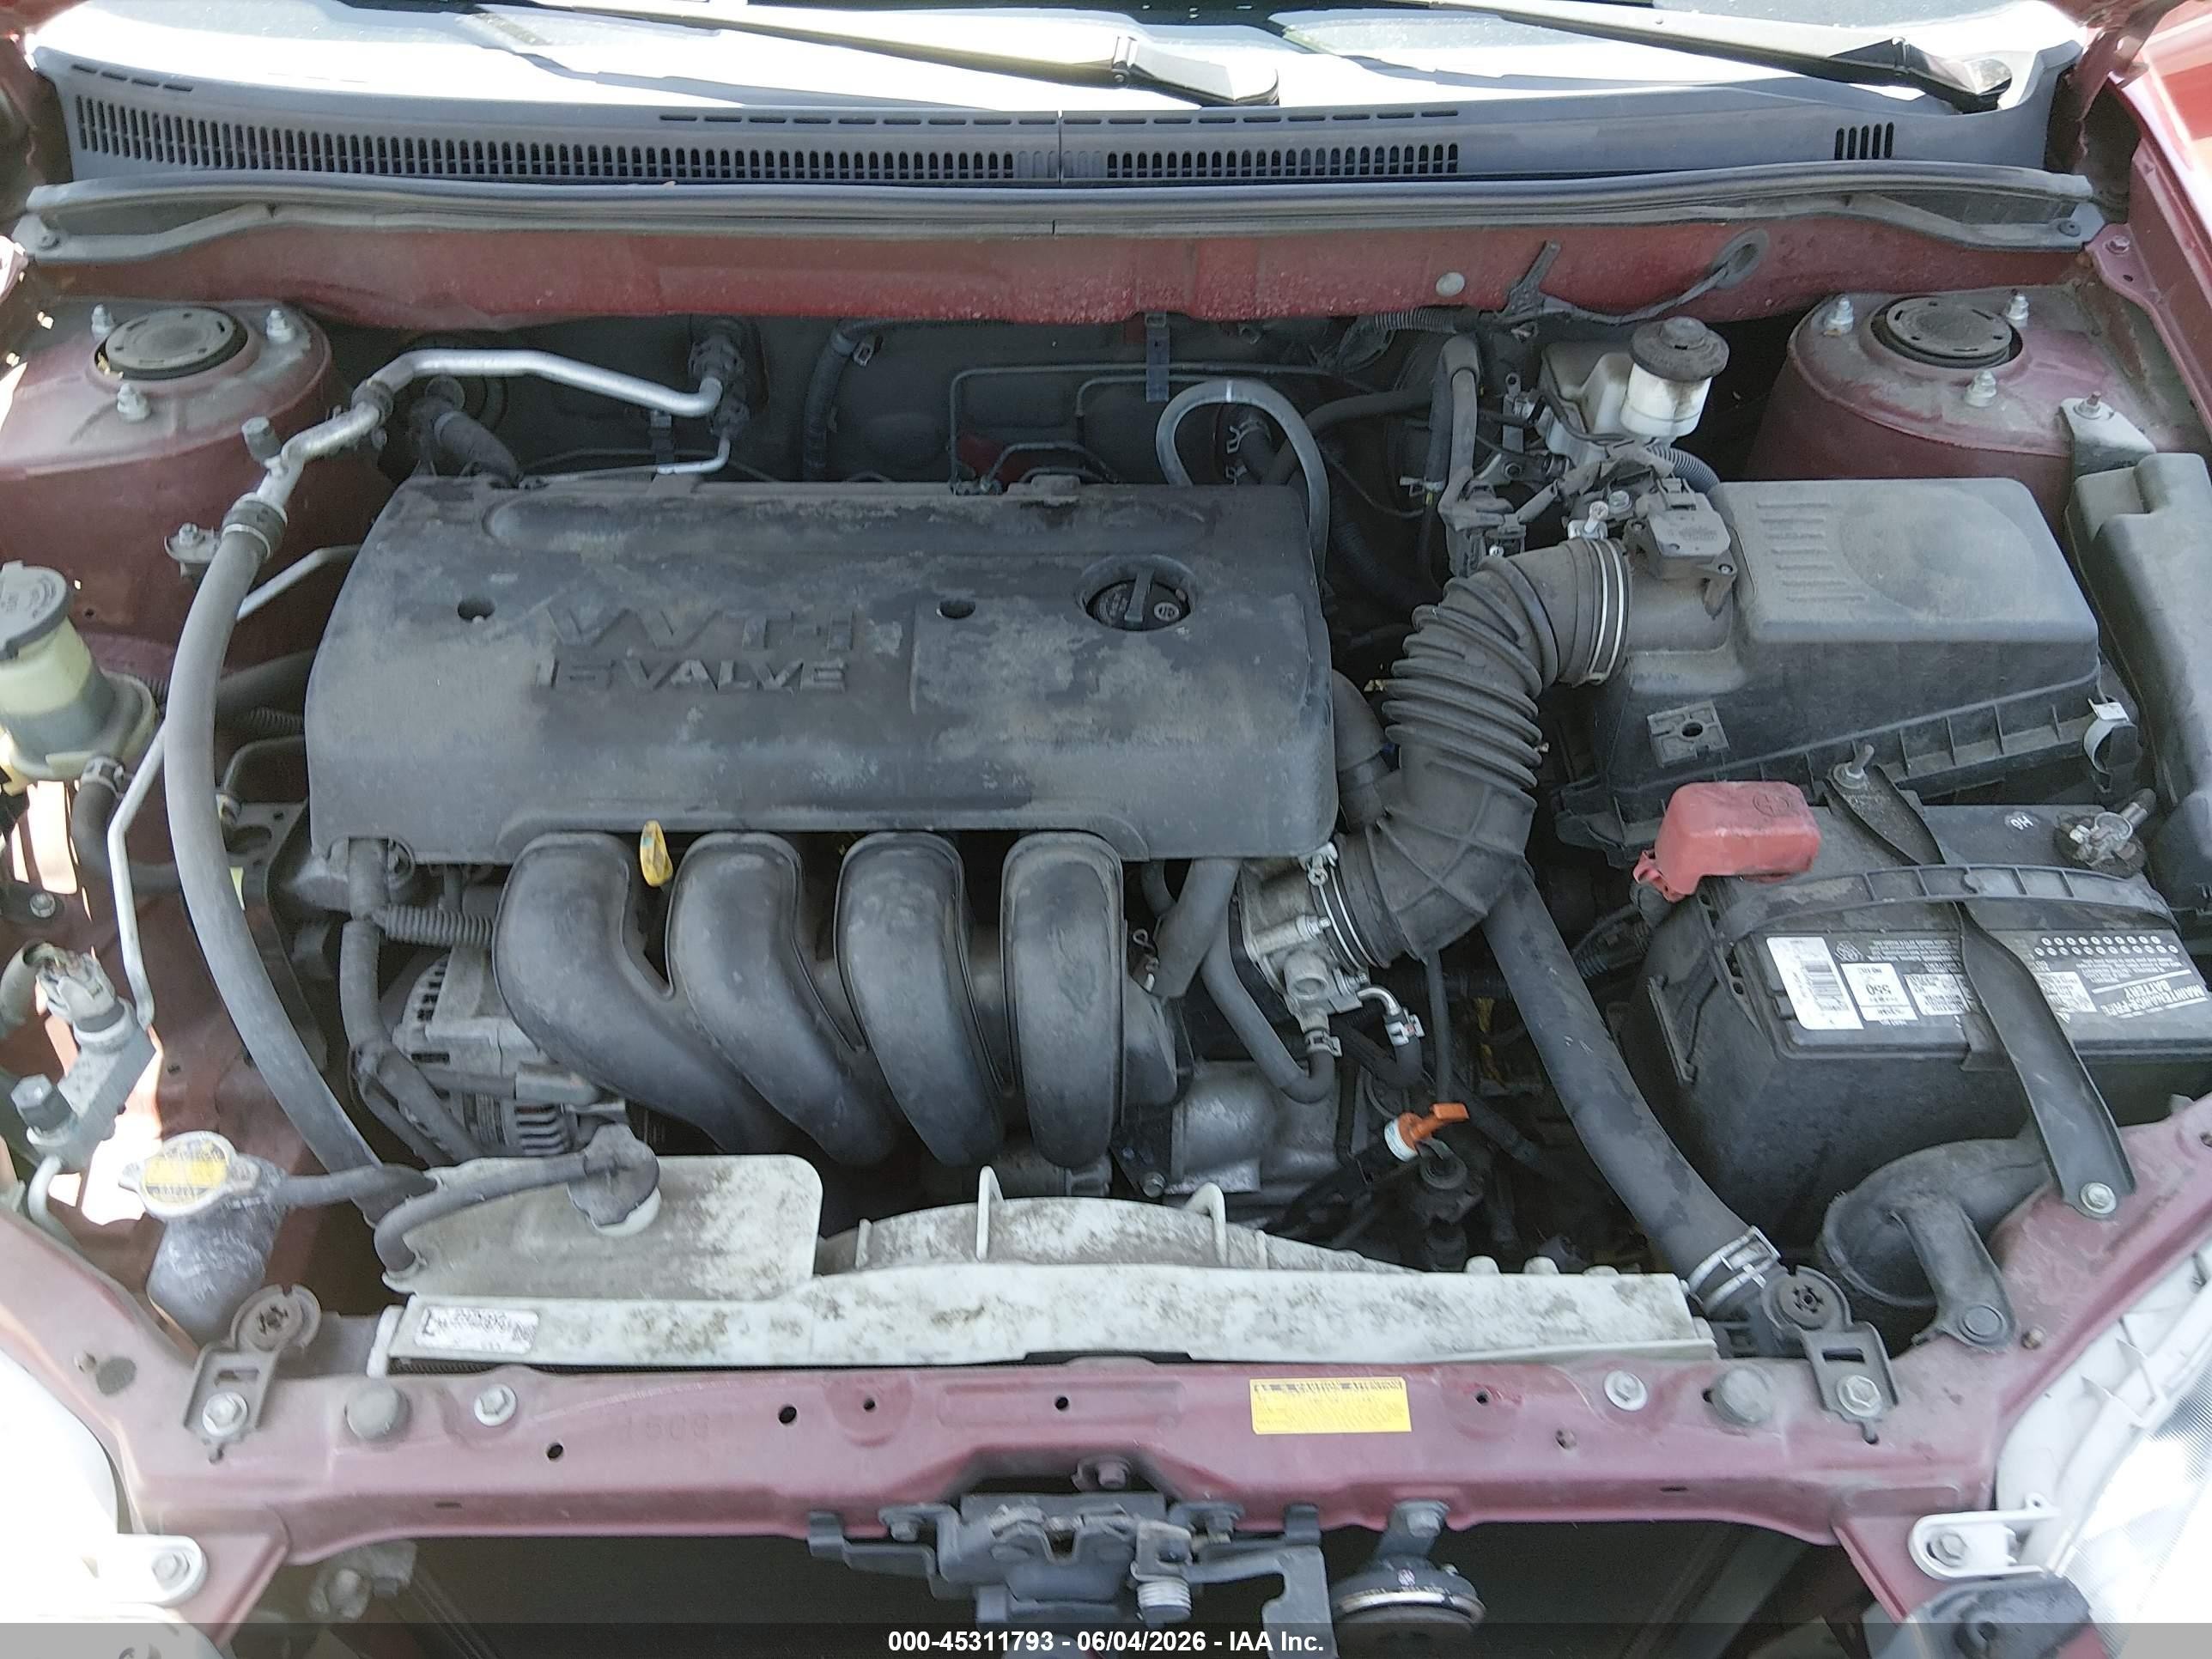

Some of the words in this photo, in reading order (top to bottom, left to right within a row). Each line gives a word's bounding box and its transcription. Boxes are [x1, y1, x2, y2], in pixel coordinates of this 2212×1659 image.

[622, 657, 848, 693] VALVE
[1865, 983, 1892, 996] 550
[2100, 984, 2205, 1017] MAINTENANCE-FREE
[2124, 979, 2172, 1000] BATTERY
